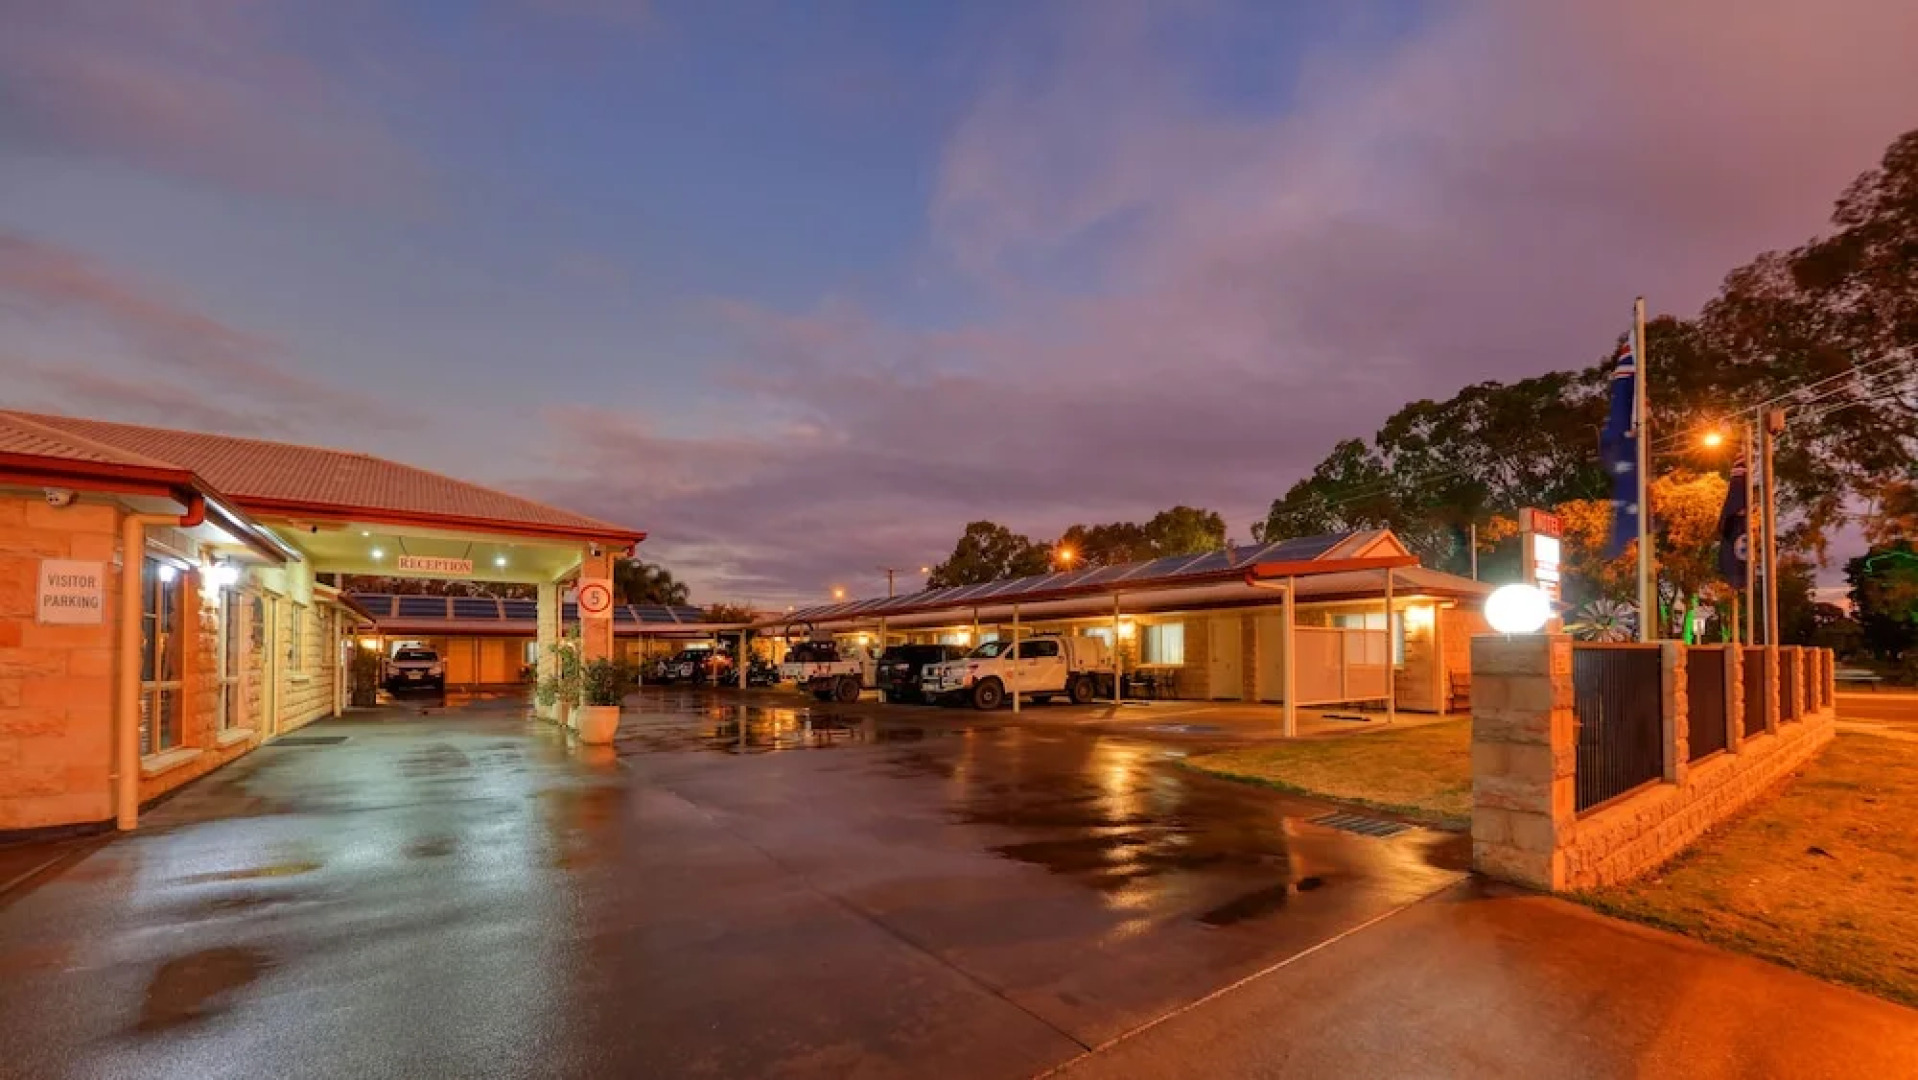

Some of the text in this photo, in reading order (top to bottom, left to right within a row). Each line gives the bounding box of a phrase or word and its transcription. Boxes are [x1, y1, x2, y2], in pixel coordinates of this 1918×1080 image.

[399, 557, 471, 571] RECEPTION
[47, 573, 96, 588] VISITOR
[43, 594, 99, 609] PARKING
[590, 590, 600, 605] 5
